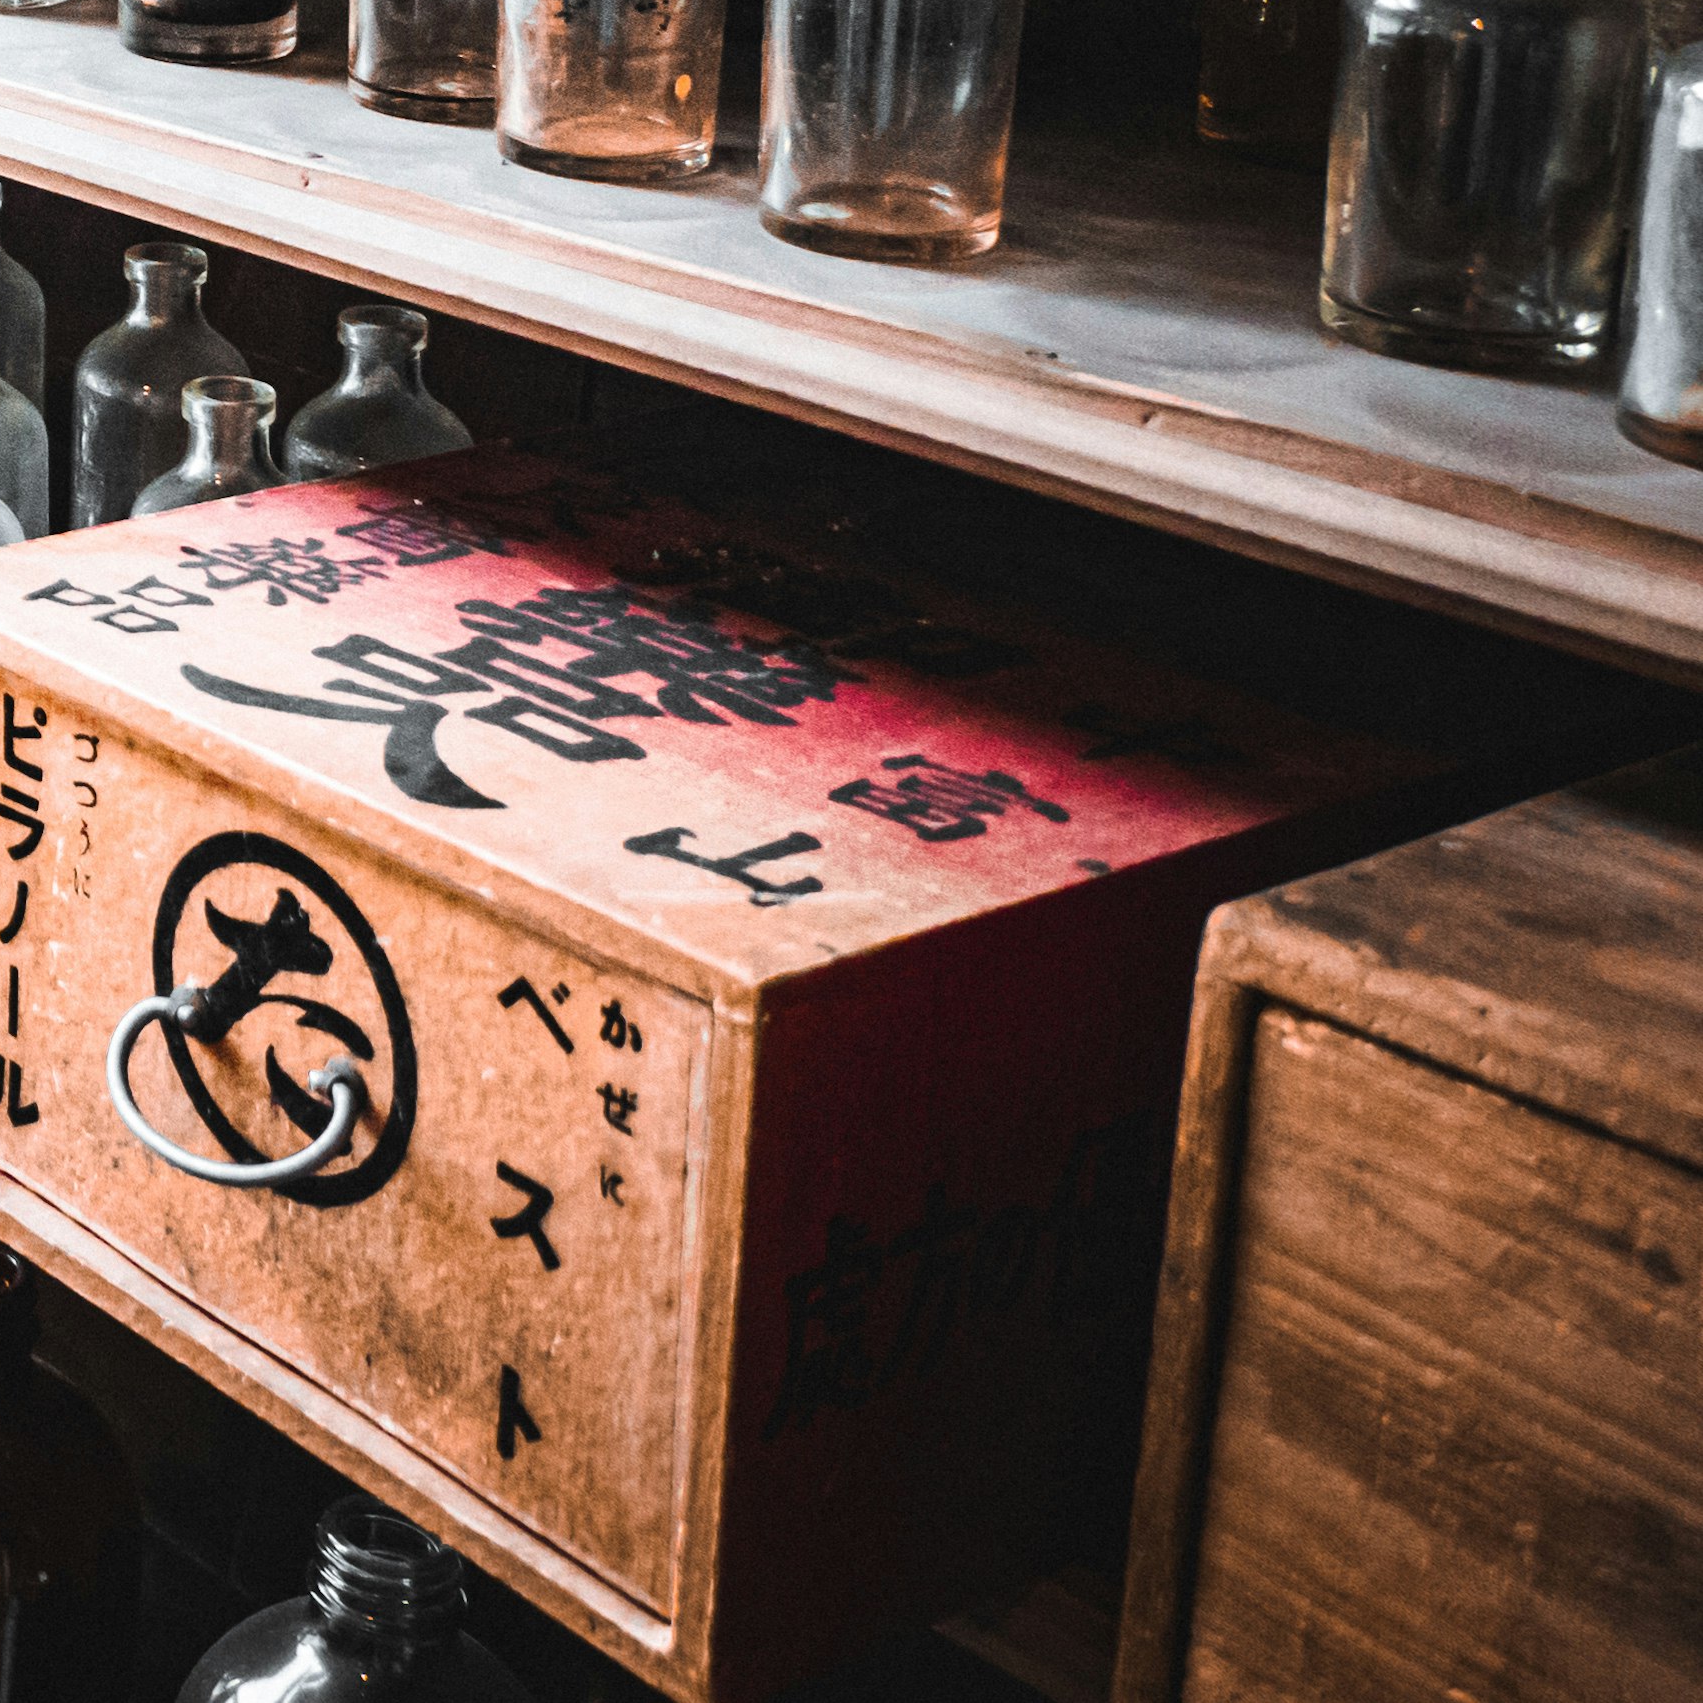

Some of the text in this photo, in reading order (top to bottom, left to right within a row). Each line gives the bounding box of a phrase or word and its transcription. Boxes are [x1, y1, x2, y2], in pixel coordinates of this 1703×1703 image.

[489, 975, 576, 1462] ベスト
[595, 998, 644, 1208] かぜに
